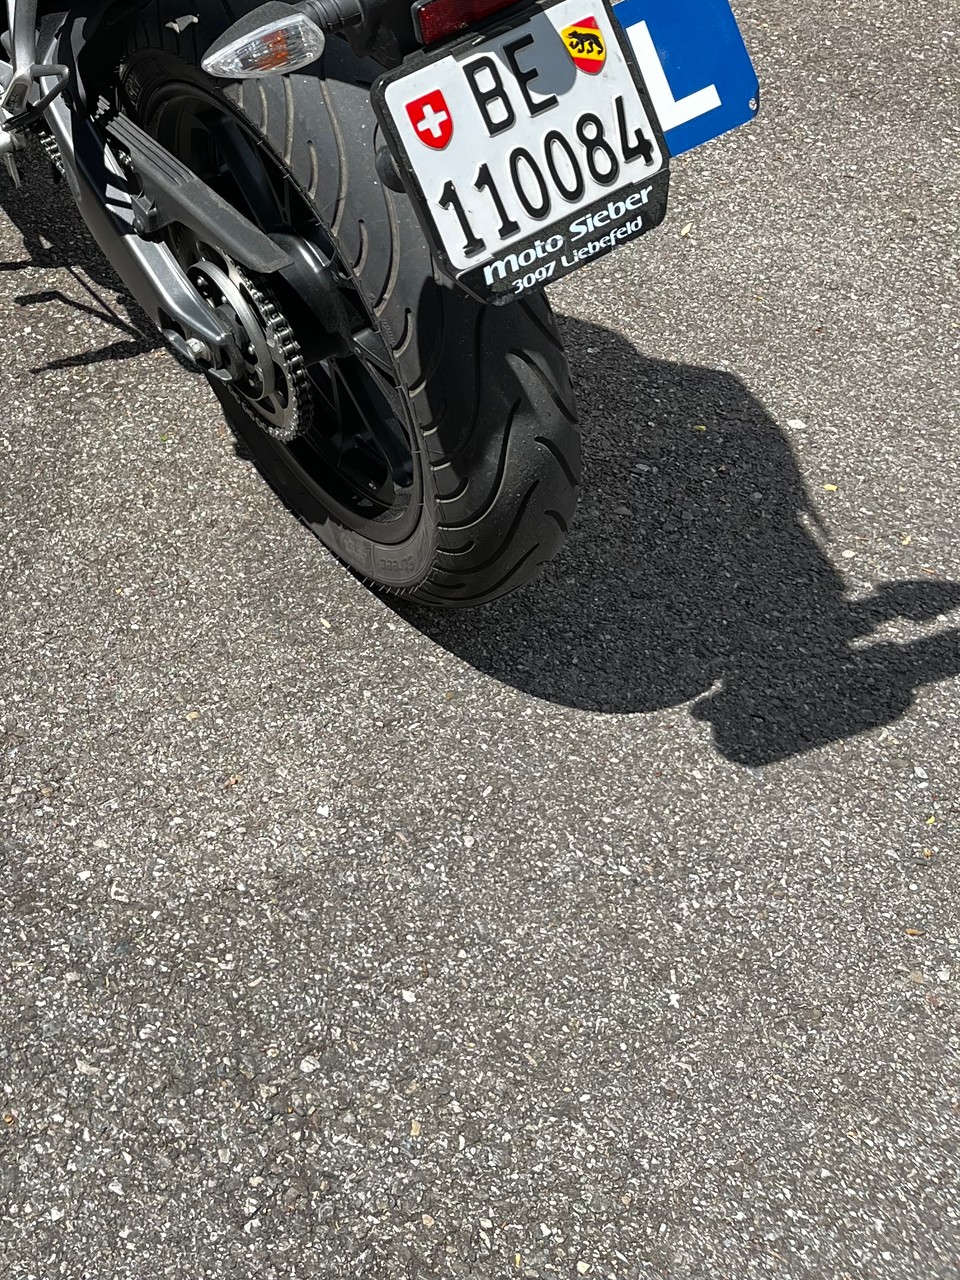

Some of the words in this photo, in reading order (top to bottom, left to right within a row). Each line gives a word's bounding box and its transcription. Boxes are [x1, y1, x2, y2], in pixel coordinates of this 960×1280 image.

[463, 34, 558, 136] BE
[625, 20, 722, 132] L
[439, 96, 653, 256] 110084
[569, 186, 654, 242] Sieber
[511, 261, 556, 294] 3097
[561, 215, 642, 267] Liebefeld
